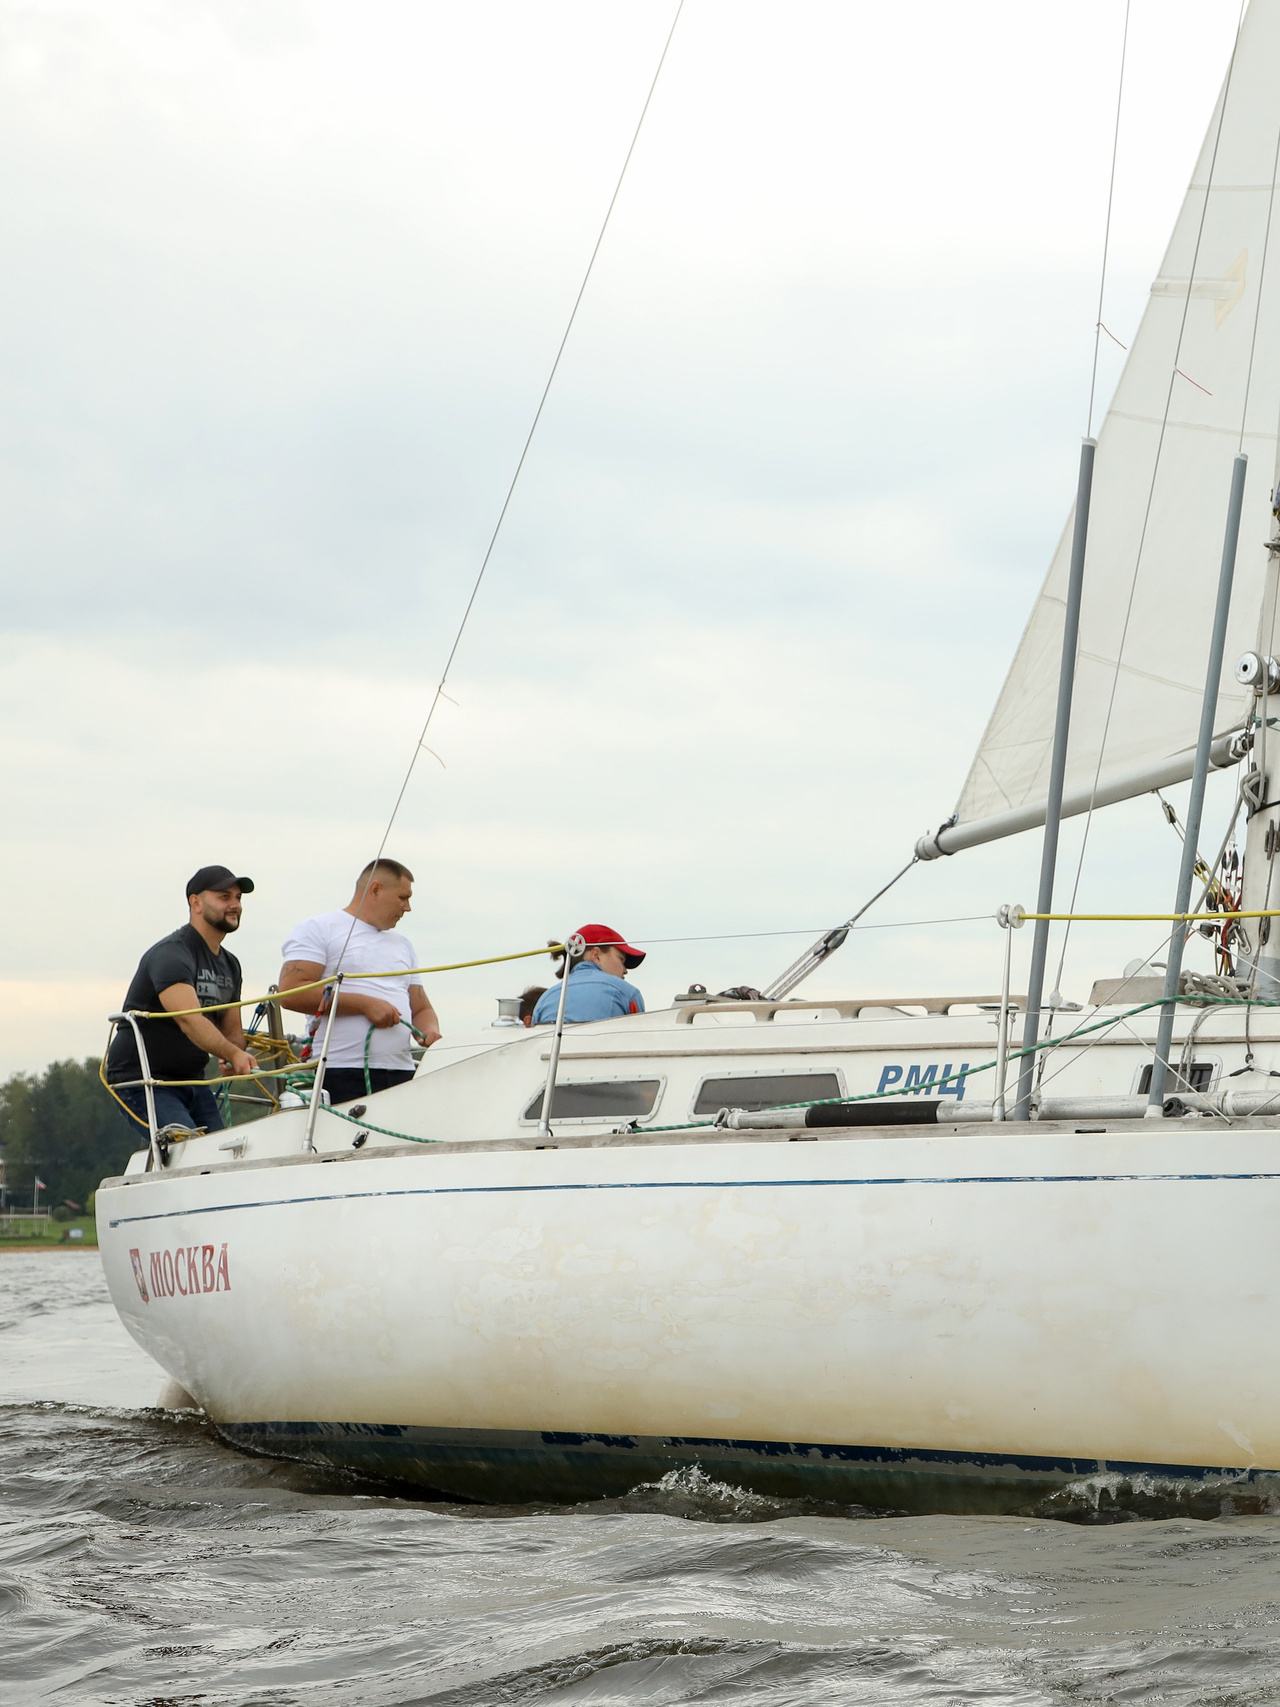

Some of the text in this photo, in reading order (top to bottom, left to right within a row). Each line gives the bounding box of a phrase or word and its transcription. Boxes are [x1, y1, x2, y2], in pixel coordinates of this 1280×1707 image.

[197, 968, 234, 988] UNER
[876, 1063, 970, 1101] РМЦ
[149, 1243, 232, 1298] МОСКВА
